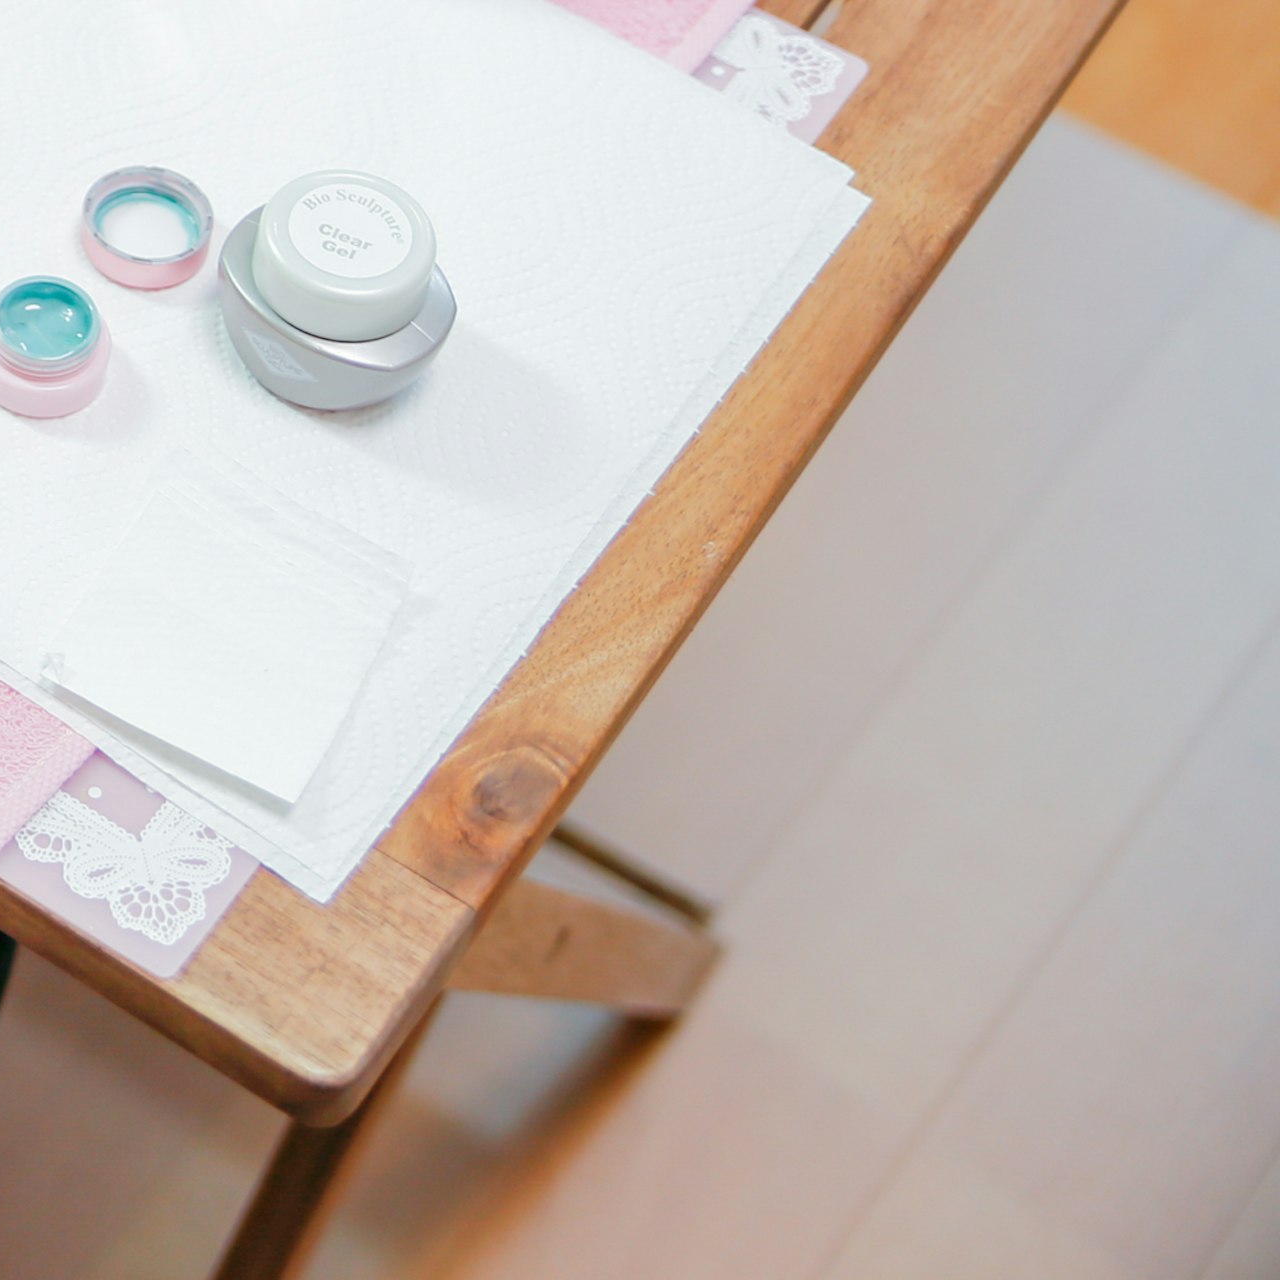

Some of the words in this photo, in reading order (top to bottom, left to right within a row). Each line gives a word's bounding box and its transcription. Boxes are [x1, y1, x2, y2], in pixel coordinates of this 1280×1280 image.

[302, 193, 331, 211] Bio
[318, 223, 373, 250] Clear
[321, 240, 357, 260] Gel
